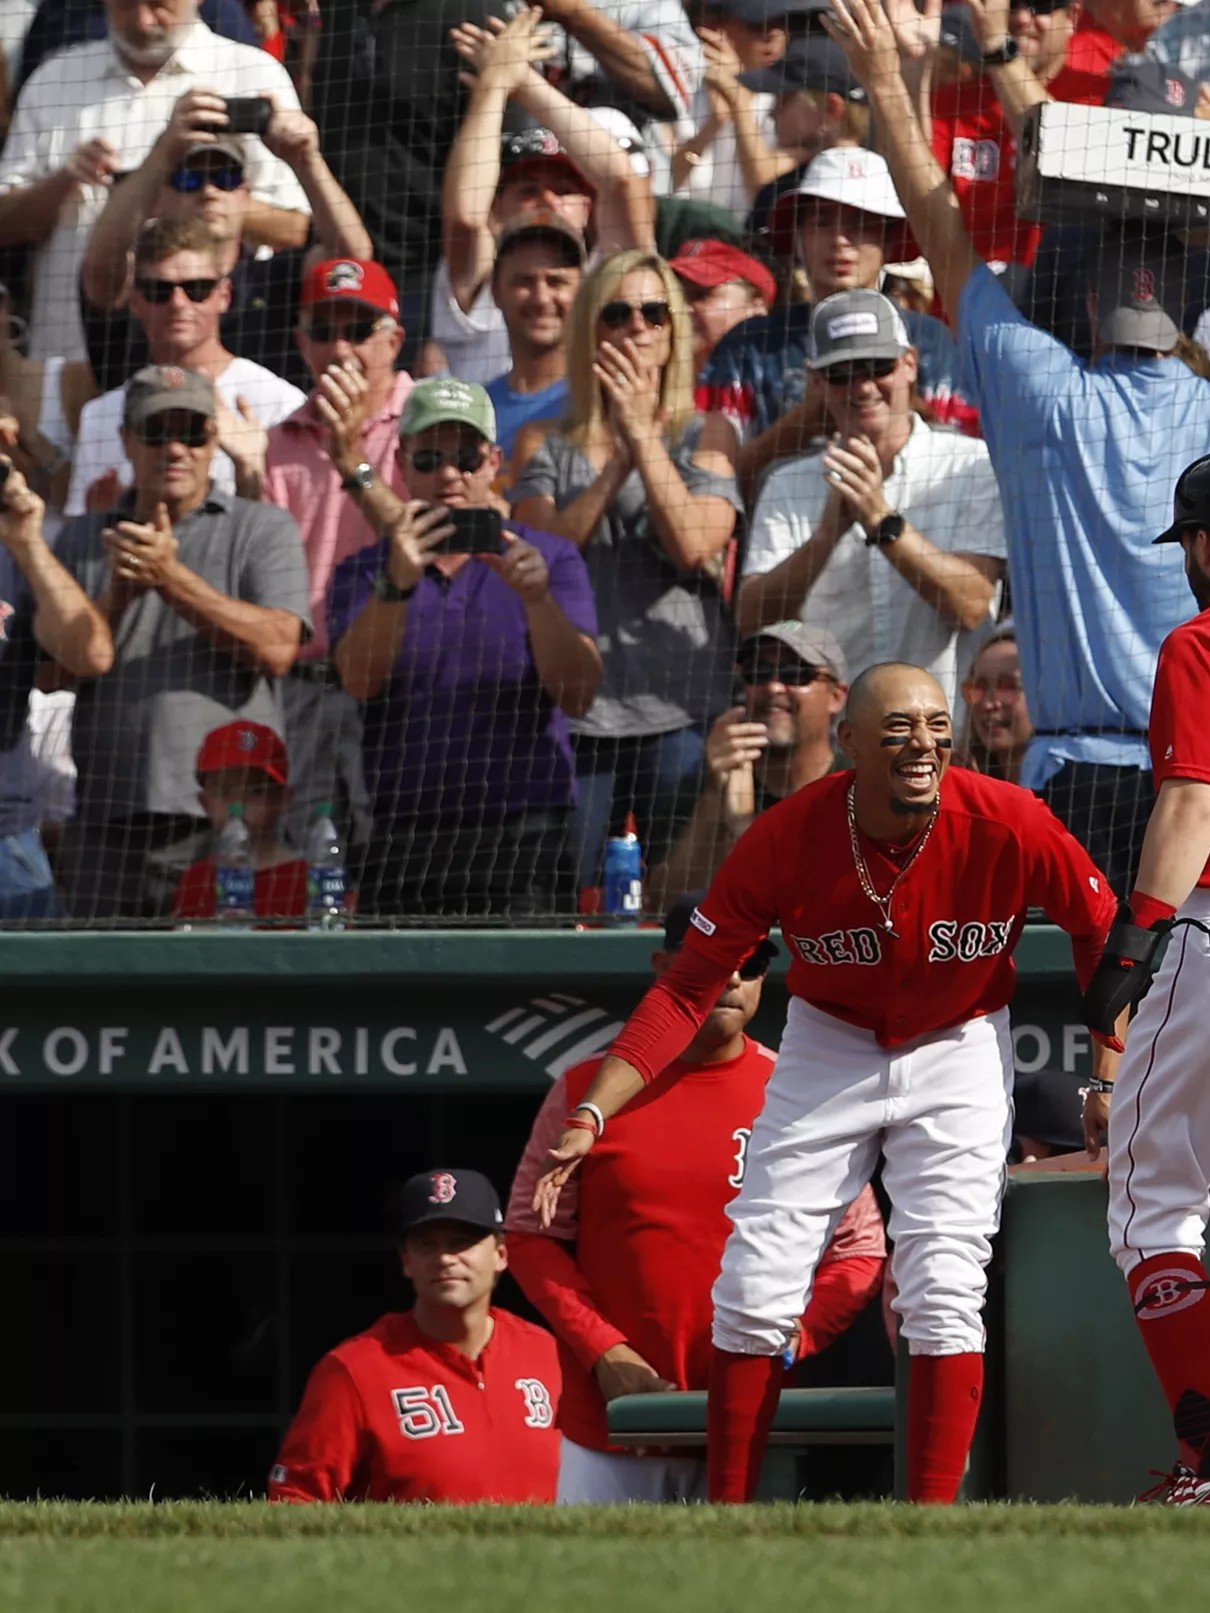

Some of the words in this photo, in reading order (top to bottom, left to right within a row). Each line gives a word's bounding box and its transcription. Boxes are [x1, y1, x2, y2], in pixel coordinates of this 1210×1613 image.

[791, 928, 881, 965] RED
[929, 914, 1015, 963] SOX
[42, 1026, 129, 1075] OF
[147, 1026, 468, 1075] AMERICA
[1012, 1023, 1088, 1074] OF
[428, 1173, 457, 1204] B
[391, 1384, 465, 1440] 51
[515, 1378, 553, 1428] B
